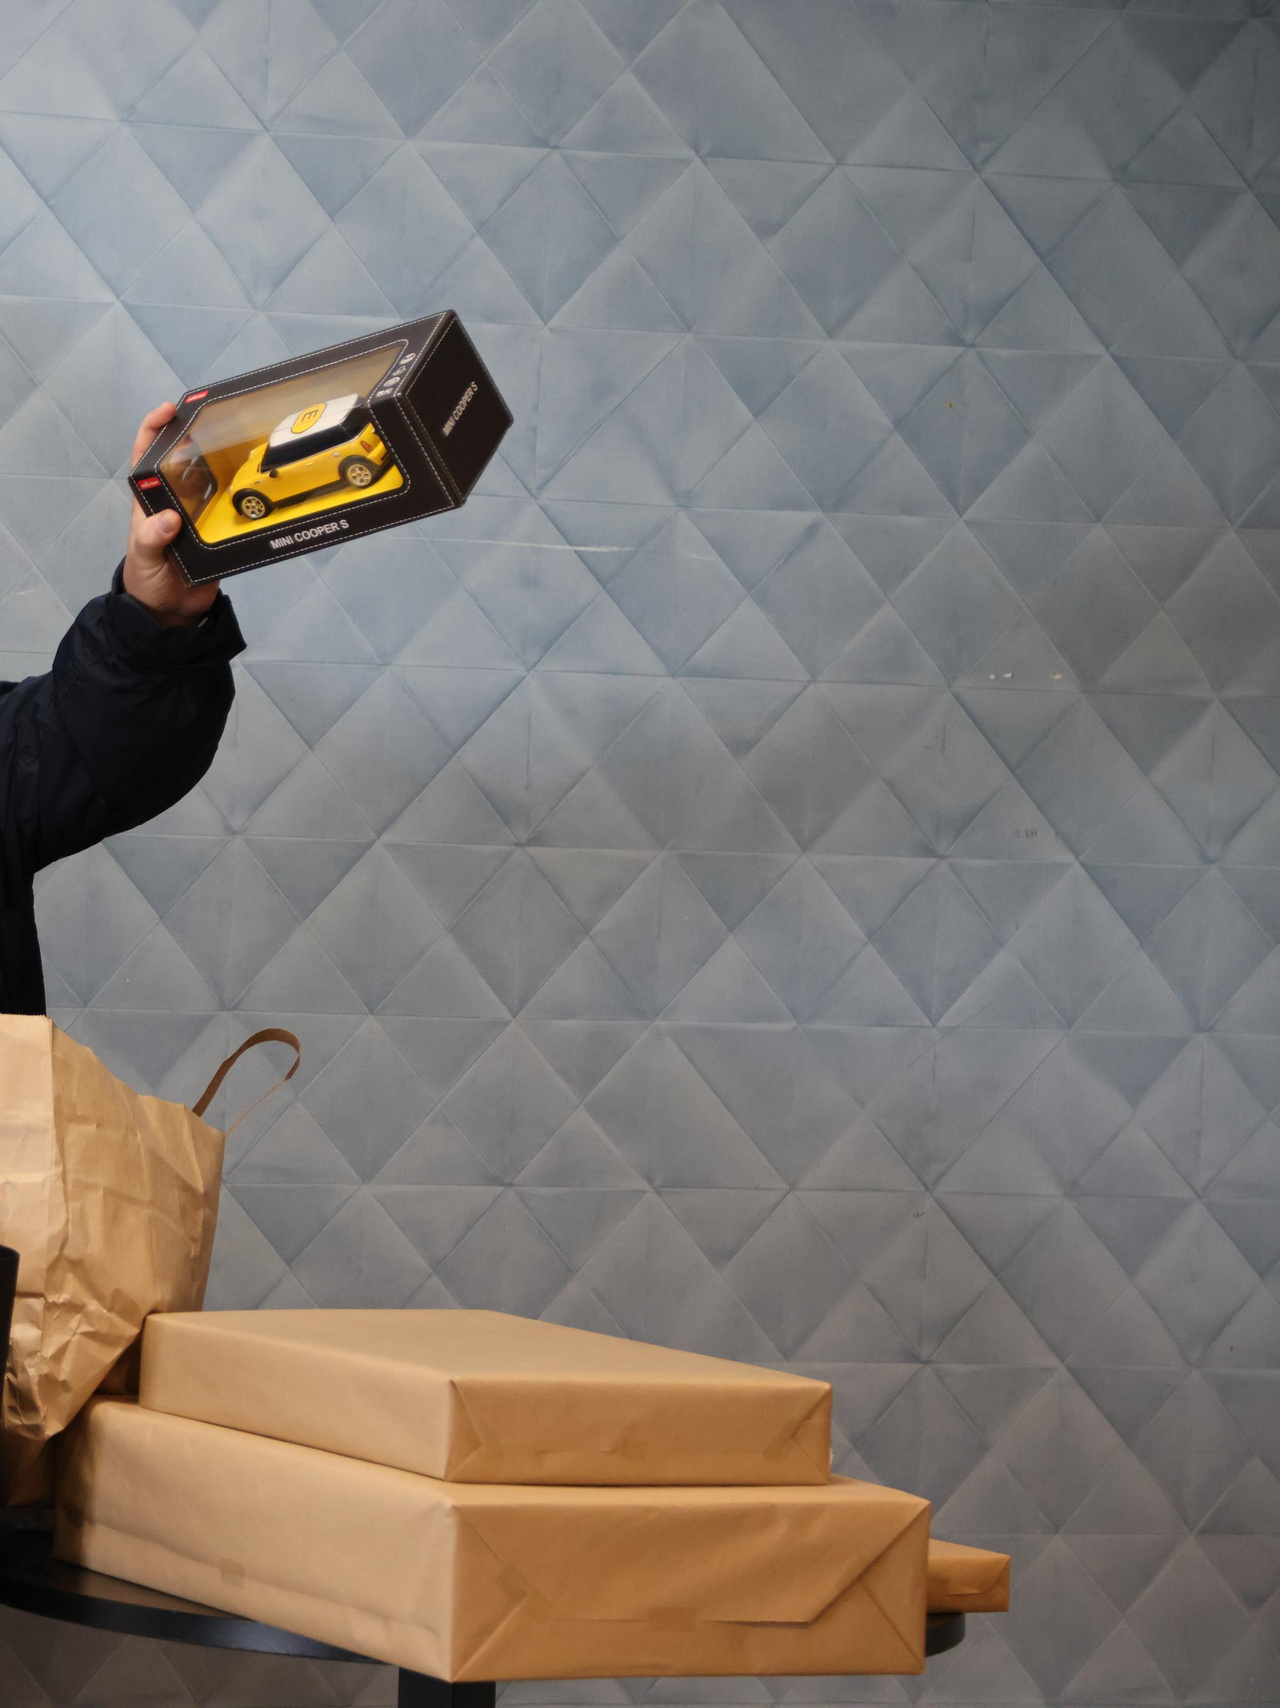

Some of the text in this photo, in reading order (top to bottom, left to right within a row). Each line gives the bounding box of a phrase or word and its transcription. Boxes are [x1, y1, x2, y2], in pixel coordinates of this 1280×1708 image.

[442, 381, 478, 437] MINI COOPER S
[270, 519, 350, 549] MINI COOPER S
